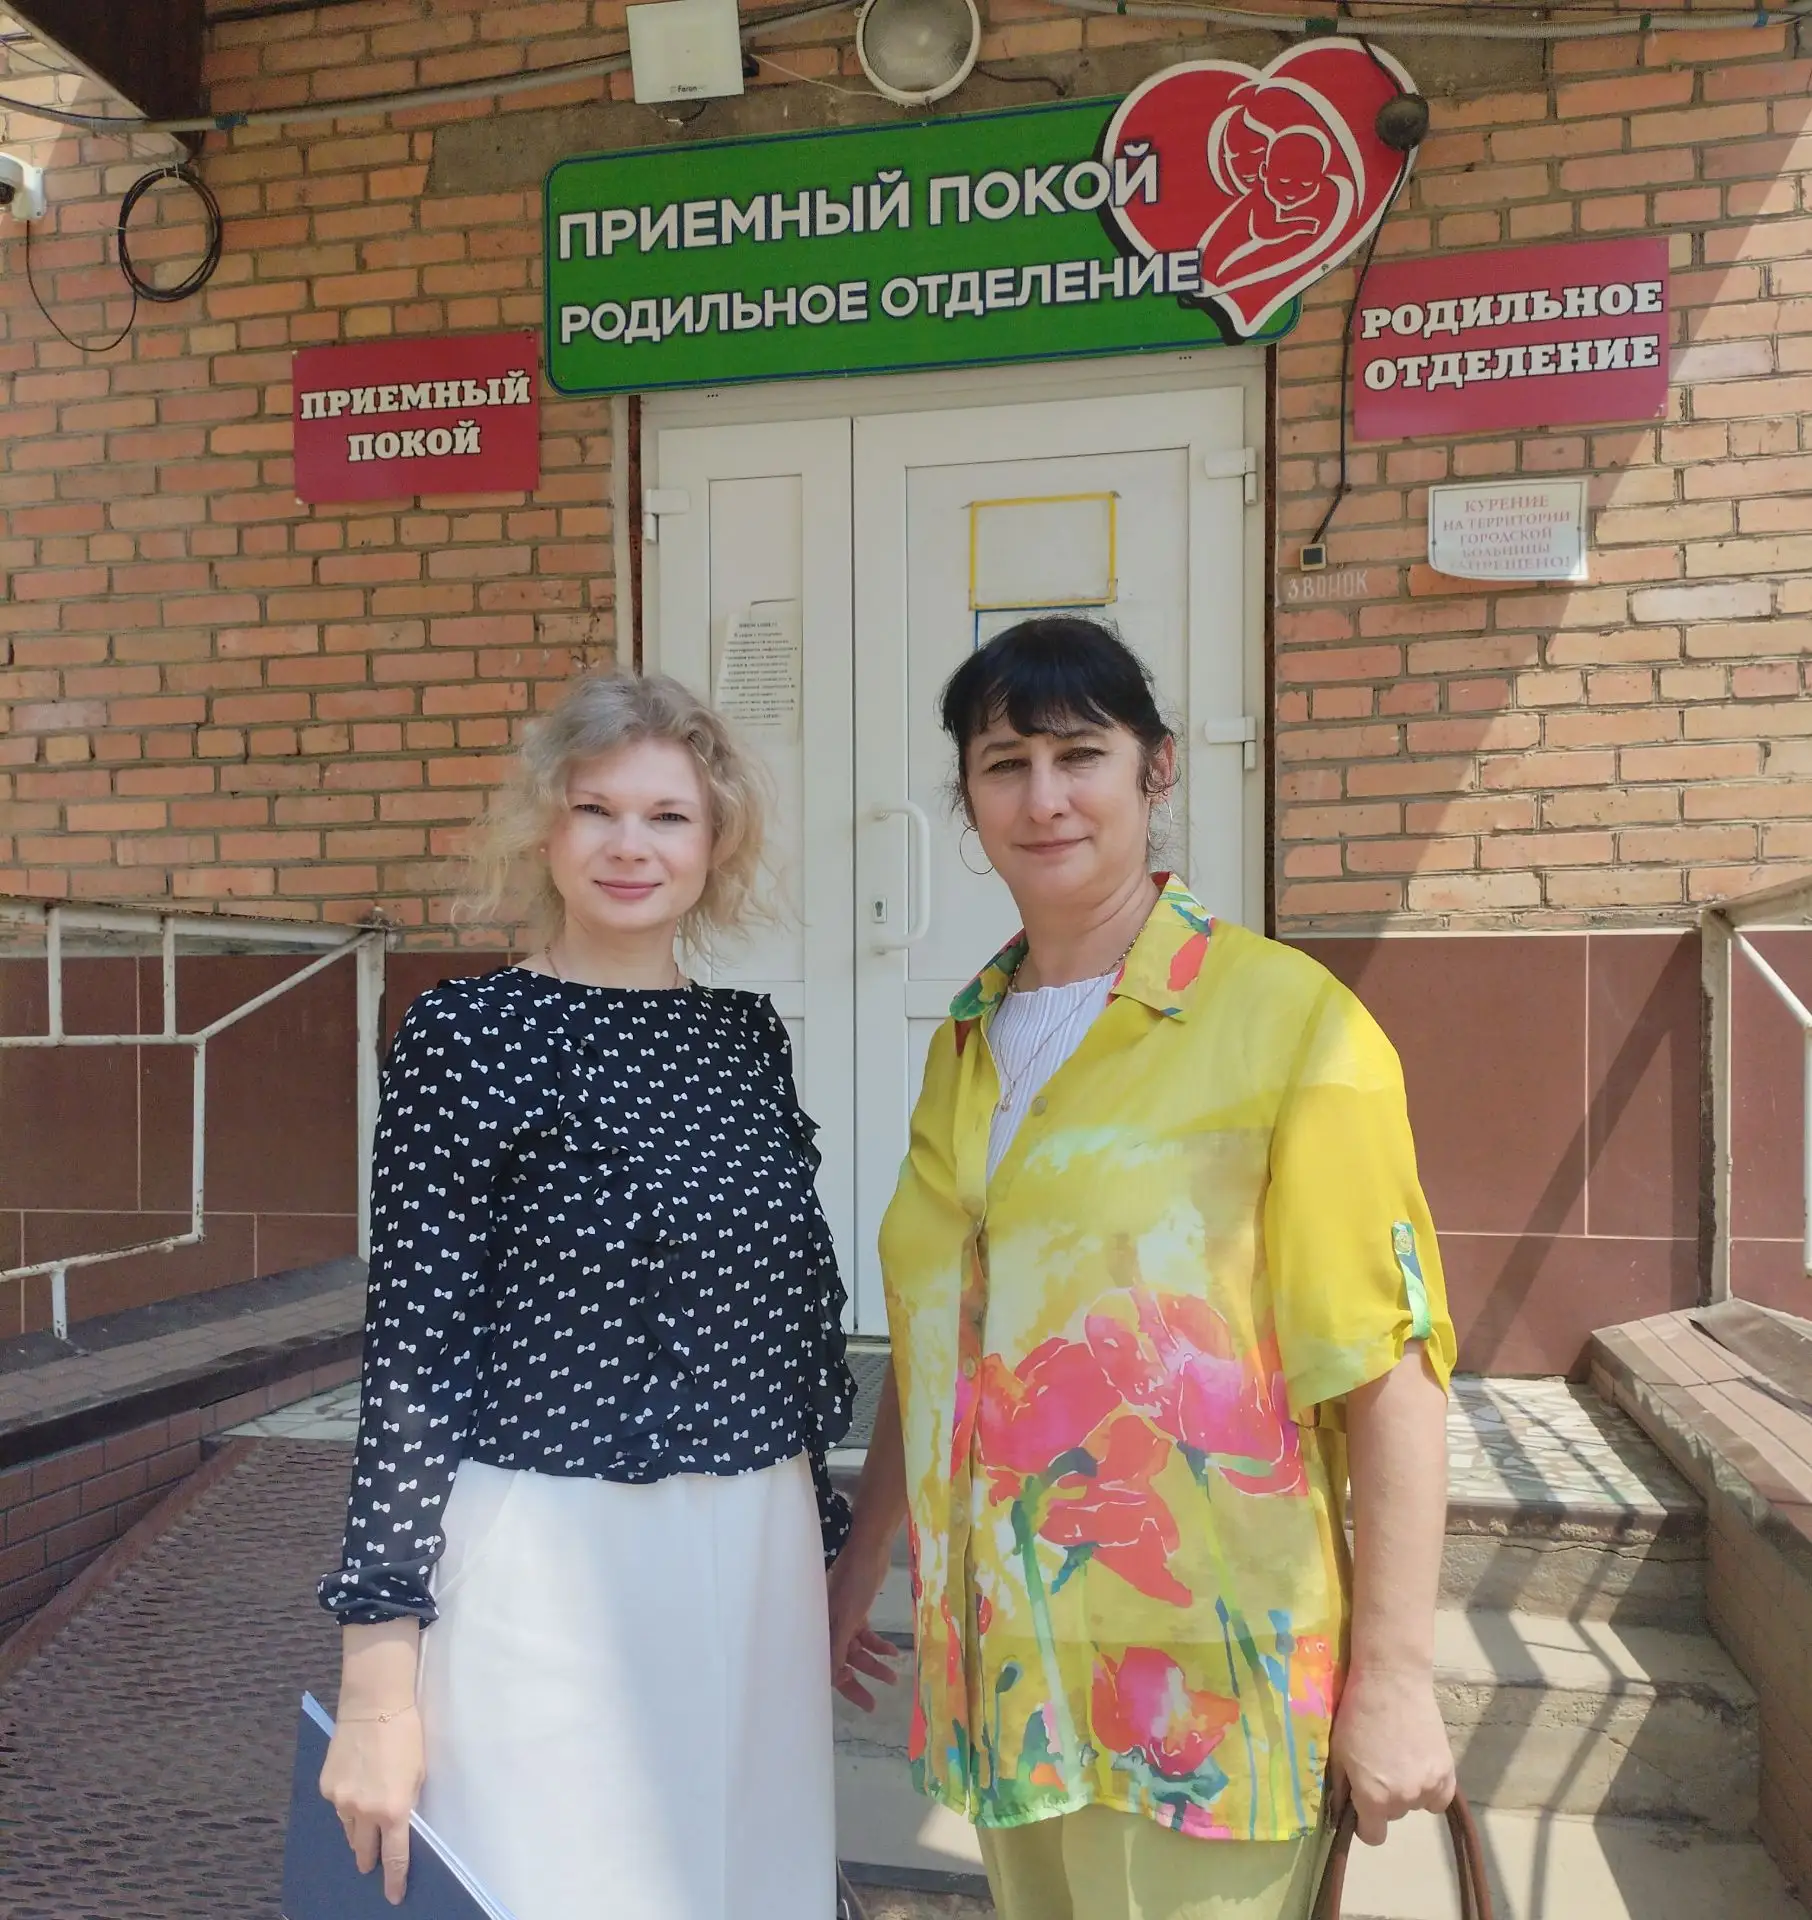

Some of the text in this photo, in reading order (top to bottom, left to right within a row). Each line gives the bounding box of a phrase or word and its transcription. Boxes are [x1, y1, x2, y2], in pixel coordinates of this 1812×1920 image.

[558, 142, 1160, 259] ПРИЕМНЫЙ ПОКОЙ
[560, 249, 1202, 344] РОДИЛЬНОЕ ОТДЕЛЕНИЕ
[1360, 281, 1665, 340] РОДИЛЬНОЕ
[1362, 334, 1662, 392] ОТДЕЛЕНИЕ
[300, 368, 533, 422] ПРИЕМНЫЙ
[346, 418, 482, 463] ПОКОЙ
[1442, 519, 1465, 532] НА
[1464, 494, 1550, 514] КУРЕНИЕ
[1459, 526, 1553, 547] ГОРОДСКОЙ
[1287, 570, 1369, 600] ЗВОНОК
